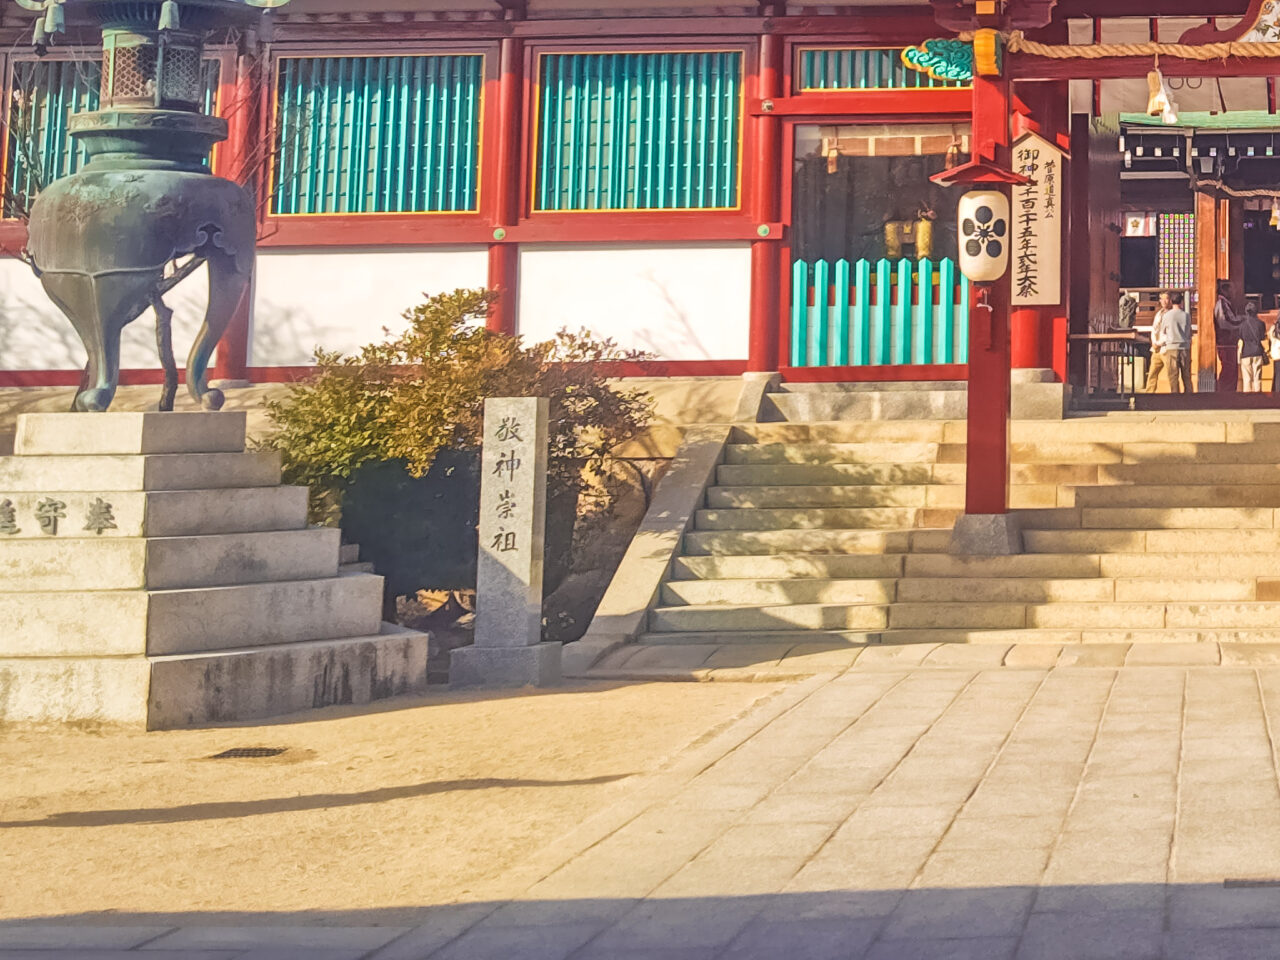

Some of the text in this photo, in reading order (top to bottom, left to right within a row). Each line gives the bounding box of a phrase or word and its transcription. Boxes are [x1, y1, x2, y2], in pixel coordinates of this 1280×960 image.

[1016, 148, 1039, 298] 御神千百二十五年式年大祭
[490, 417, 524, 552] 敬神崇祖
